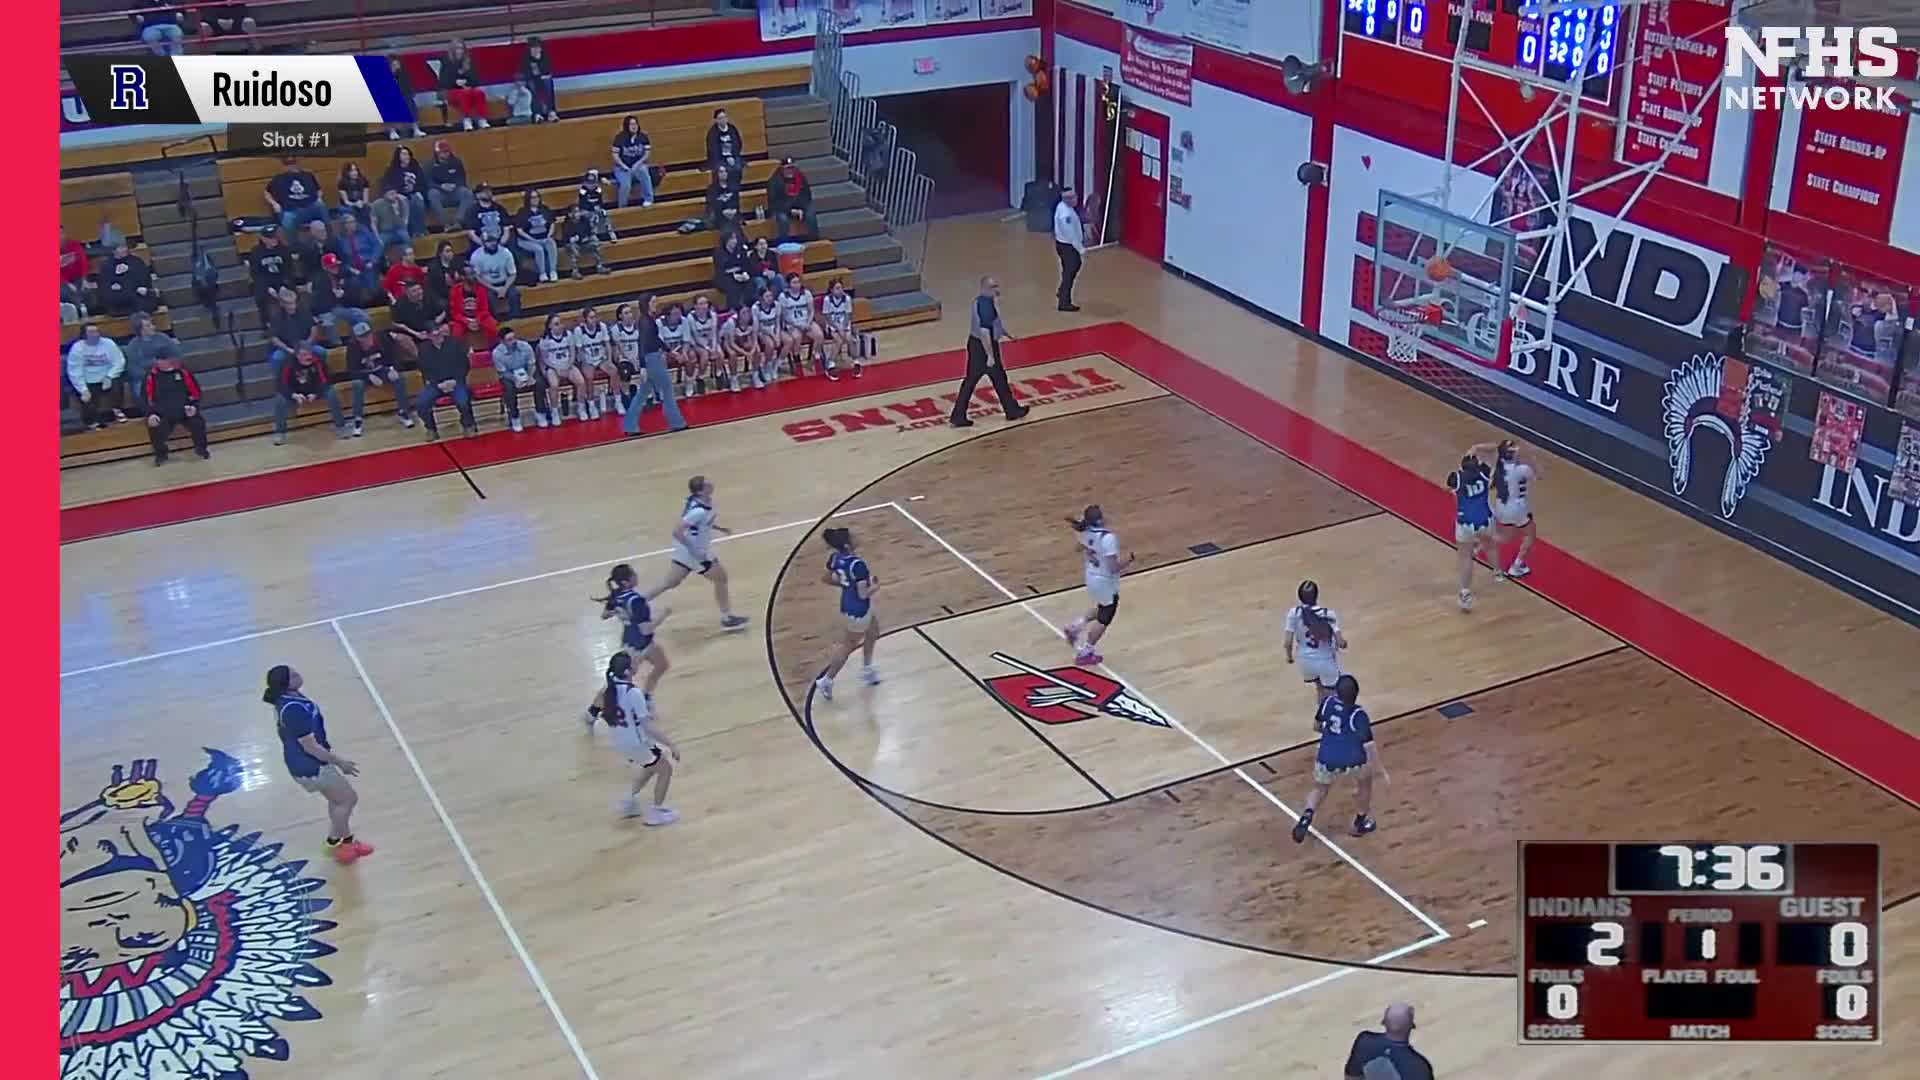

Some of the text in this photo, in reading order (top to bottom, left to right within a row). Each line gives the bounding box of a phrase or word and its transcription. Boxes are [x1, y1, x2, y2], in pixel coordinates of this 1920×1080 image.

[1814, 129, 1837, 148] STATE
[1807, 172, 1880, 205] STATE CHAMPIONS
[1465, 479, 1486, 497] 10
